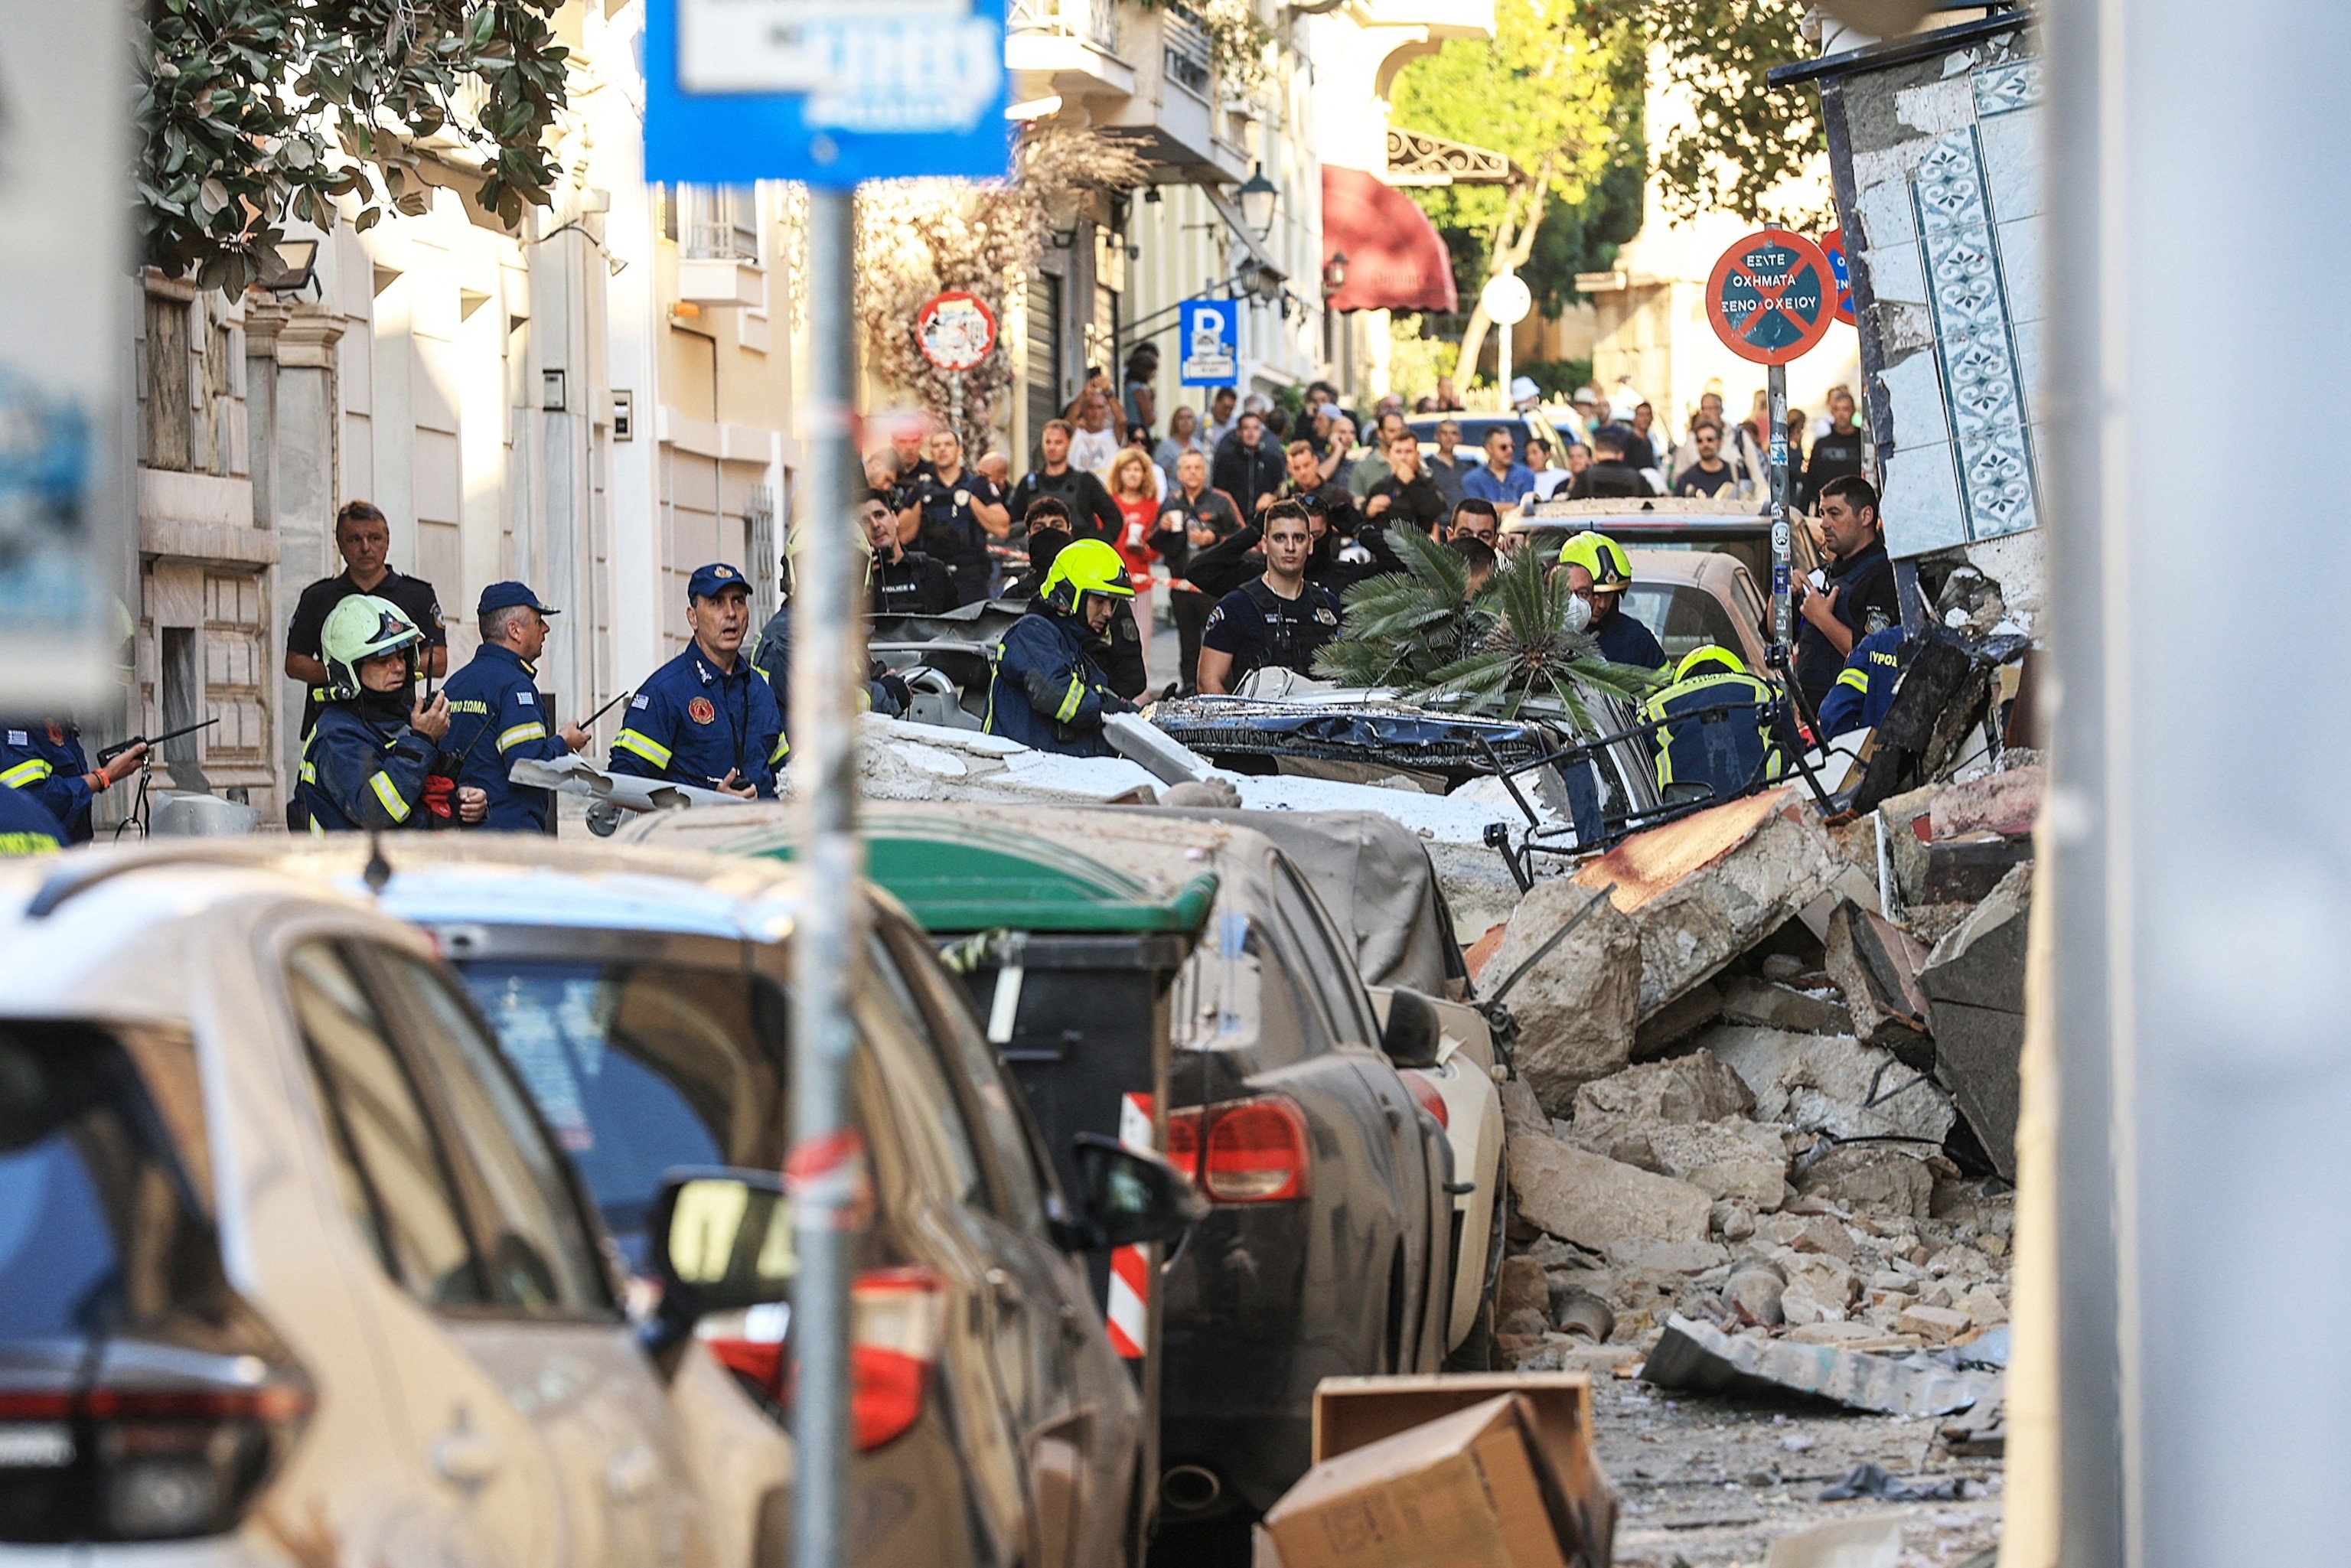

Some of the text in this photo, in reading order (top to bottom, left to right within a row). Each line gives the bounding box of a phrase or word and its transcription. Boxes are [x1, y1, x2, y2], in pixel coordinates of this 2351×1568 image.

[1733, 274, 1796, 288] ΟΧΗΜΑΤΑ
[1193, 308, 1225, 333] P
[462, 699, 487, 715] ΣΩΜΑ
